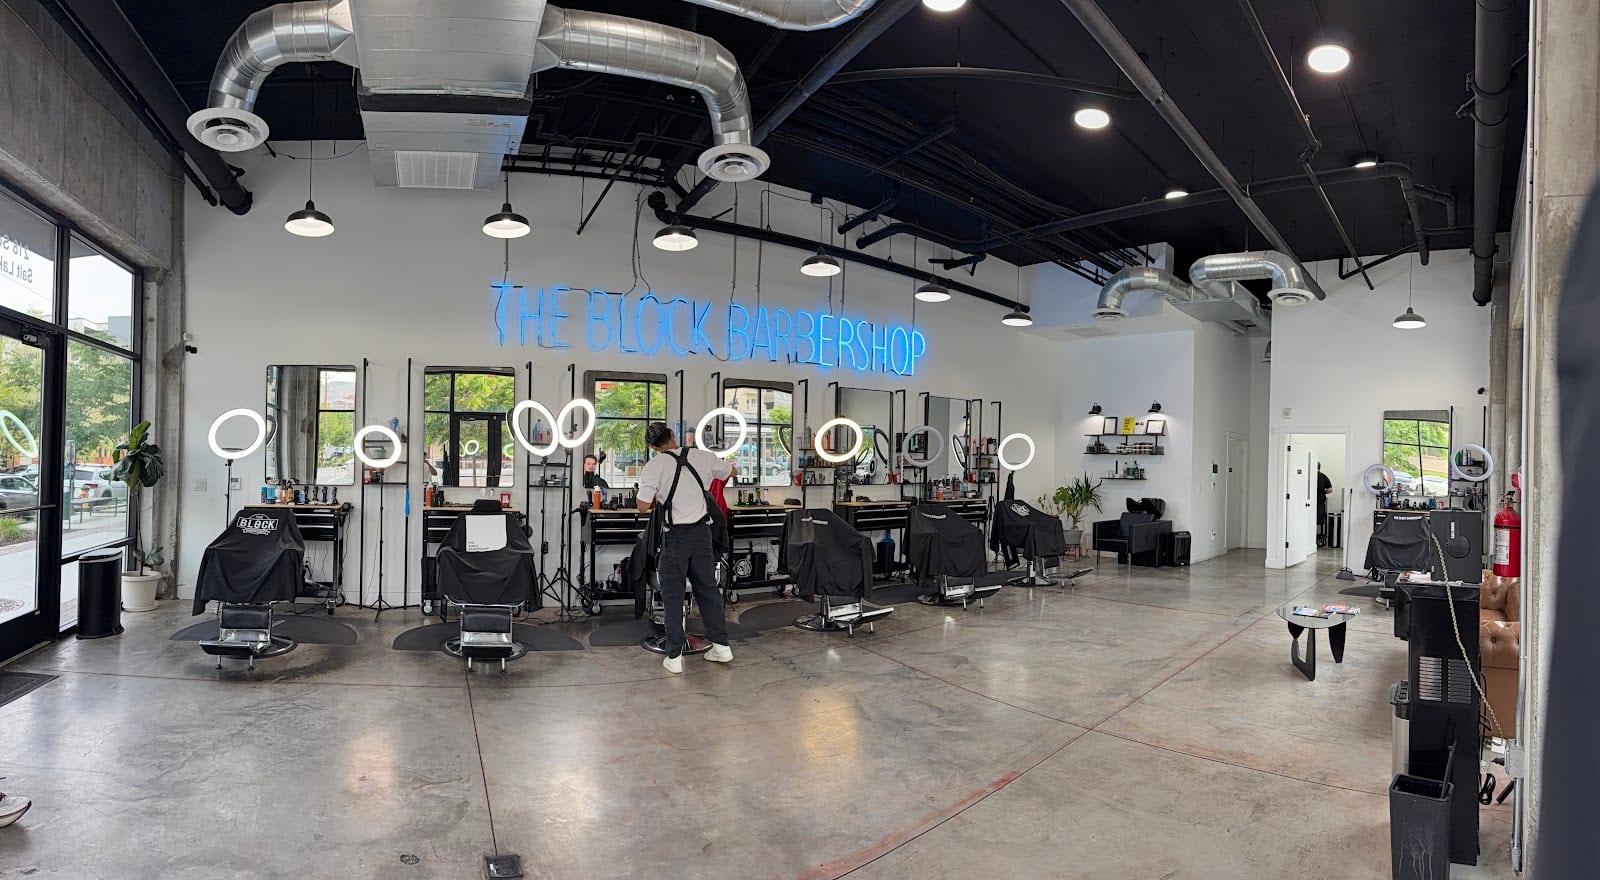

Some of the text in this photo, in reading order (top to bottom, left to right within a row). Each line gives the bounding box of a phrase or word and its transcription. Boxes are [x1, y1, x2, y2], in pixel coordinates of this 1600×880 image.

[490, 283, 926, 377] THE BLOCK BARBERSHOP
[240, 518, 276, 529] BLOCK
